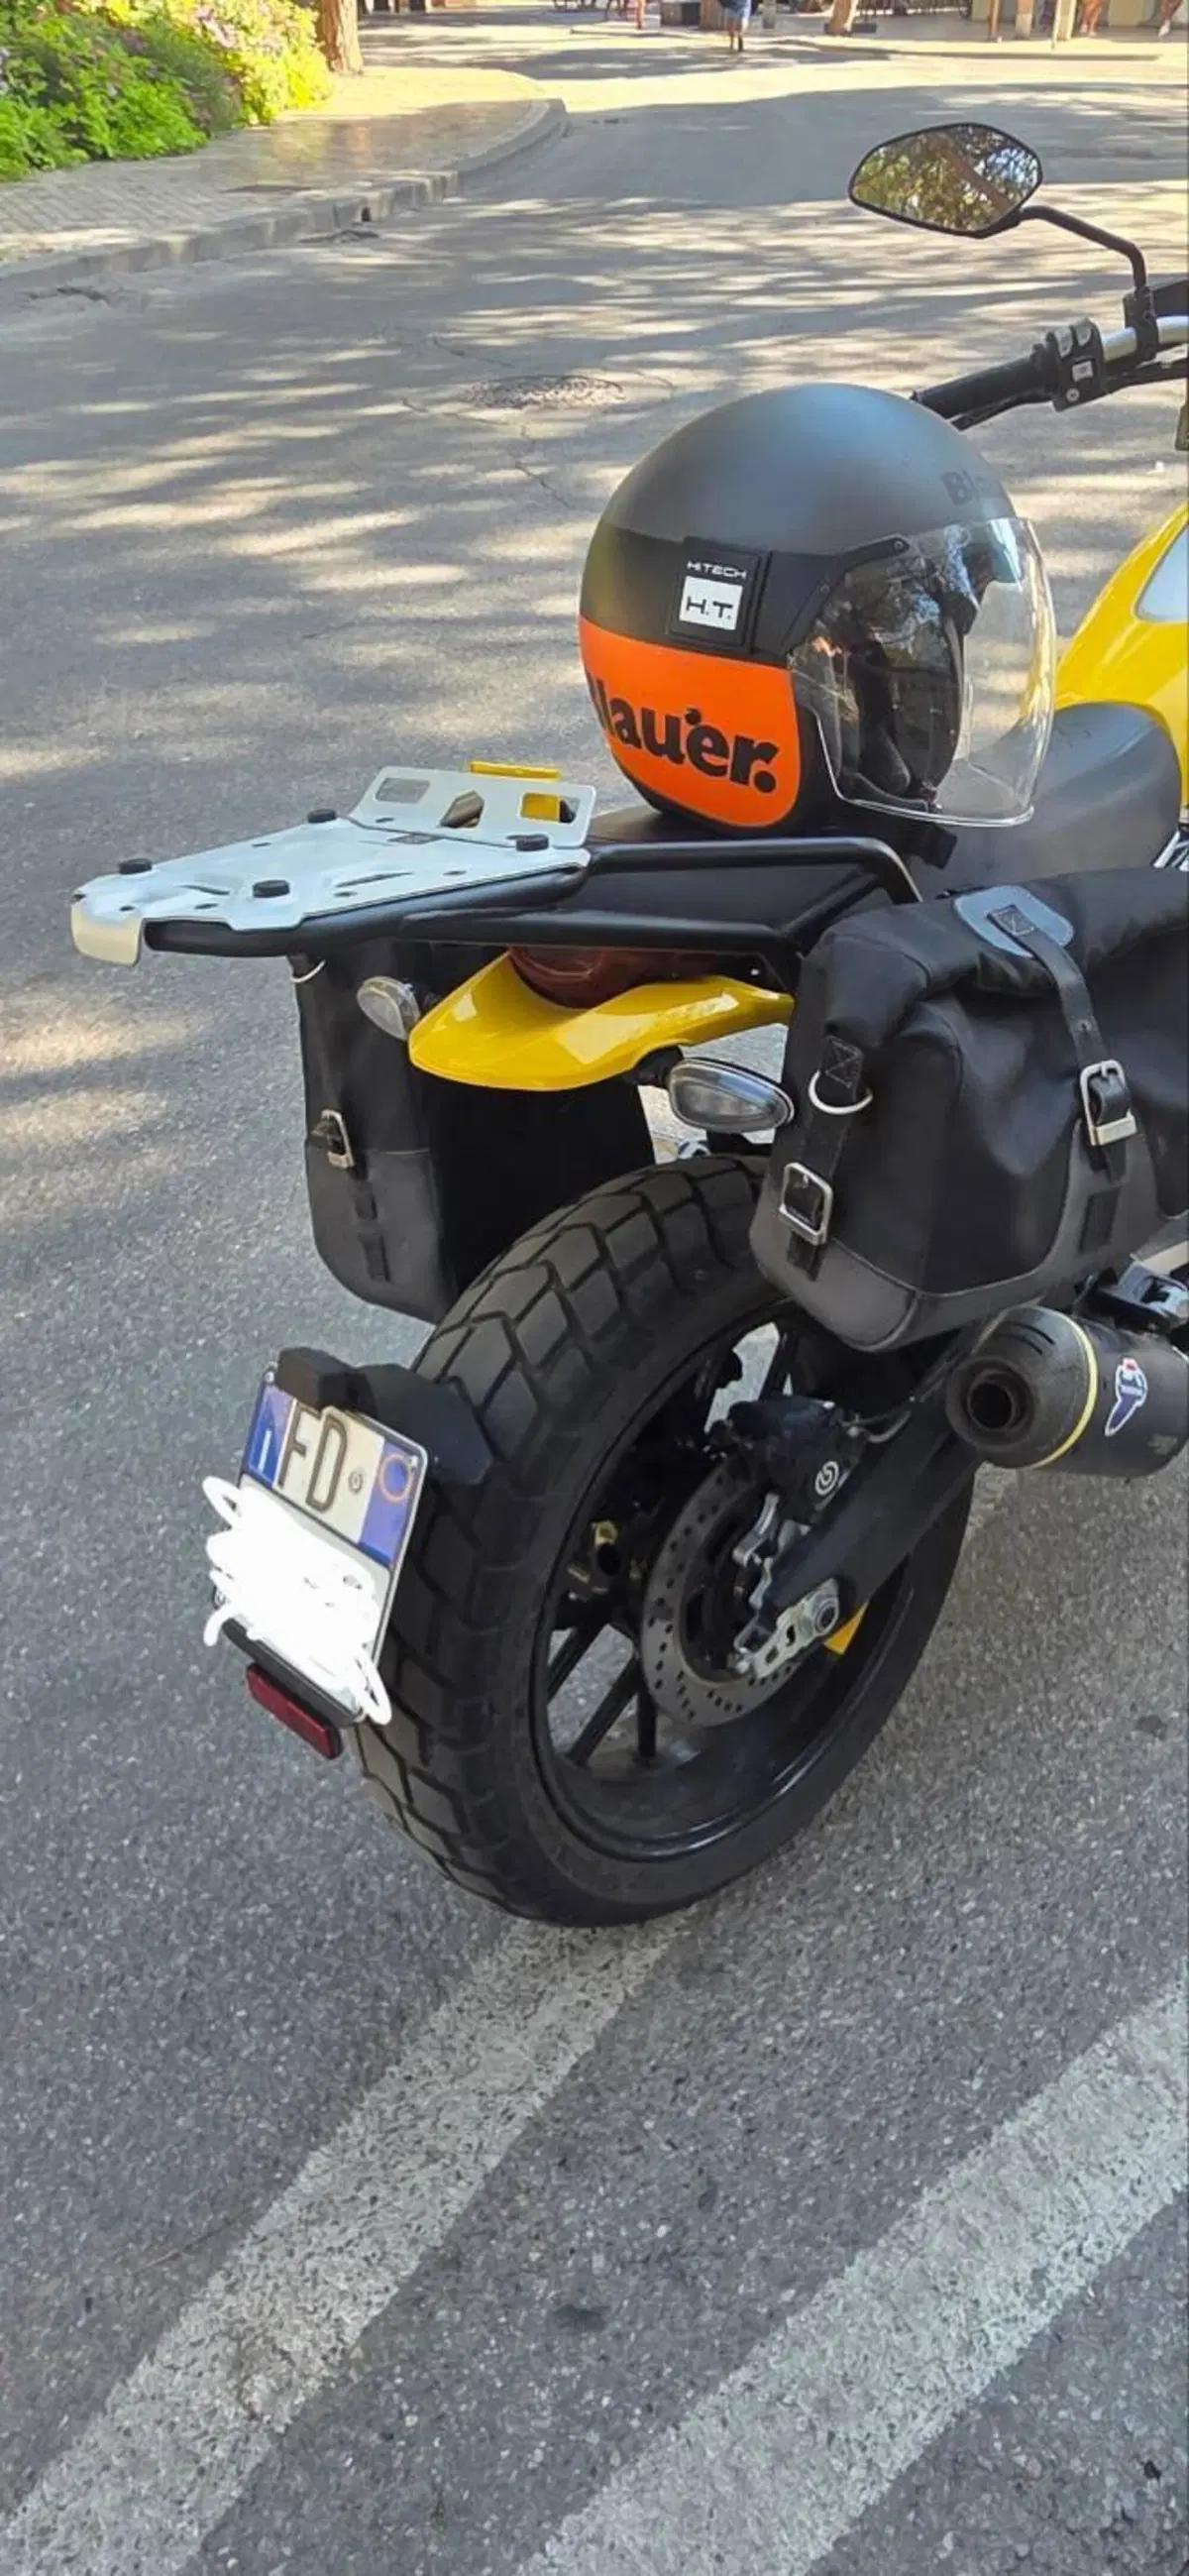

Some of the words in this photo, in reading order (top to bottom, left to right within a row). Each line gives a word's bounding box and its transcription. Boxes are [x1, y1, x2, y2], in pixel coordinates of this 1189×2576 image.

[686, 596, 733, 619] H.T.
[587, 672, 779, 794] lauer.
[277, 1402, 347, 1512] FD
